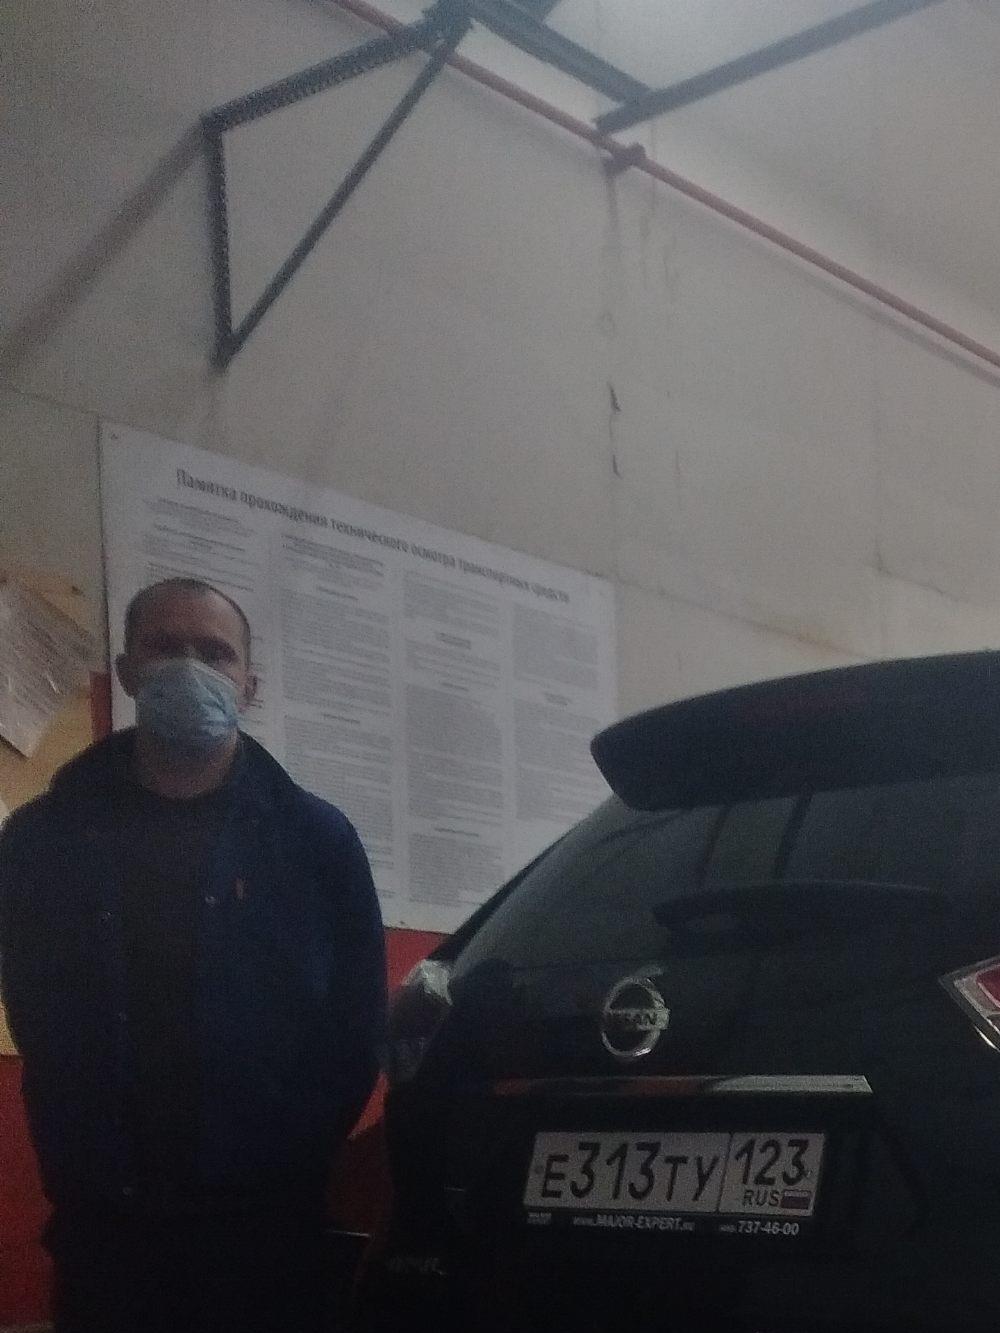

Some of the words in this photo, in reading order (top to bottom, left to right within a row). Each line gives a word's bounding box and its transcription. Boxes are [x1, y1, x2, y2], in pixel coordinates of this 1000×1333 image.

[176, 468, 237, 500] Памятка
[239, 491, 329, 528] прохождения
[331, 518, 409, 552] технического
[411, 543, 456, 568] осмотра
[541, 1141, 720, 1200] Е313ТУ
[735, 1139, 810, 1186] 123
[743, 1189, 780, 1207] RUS
